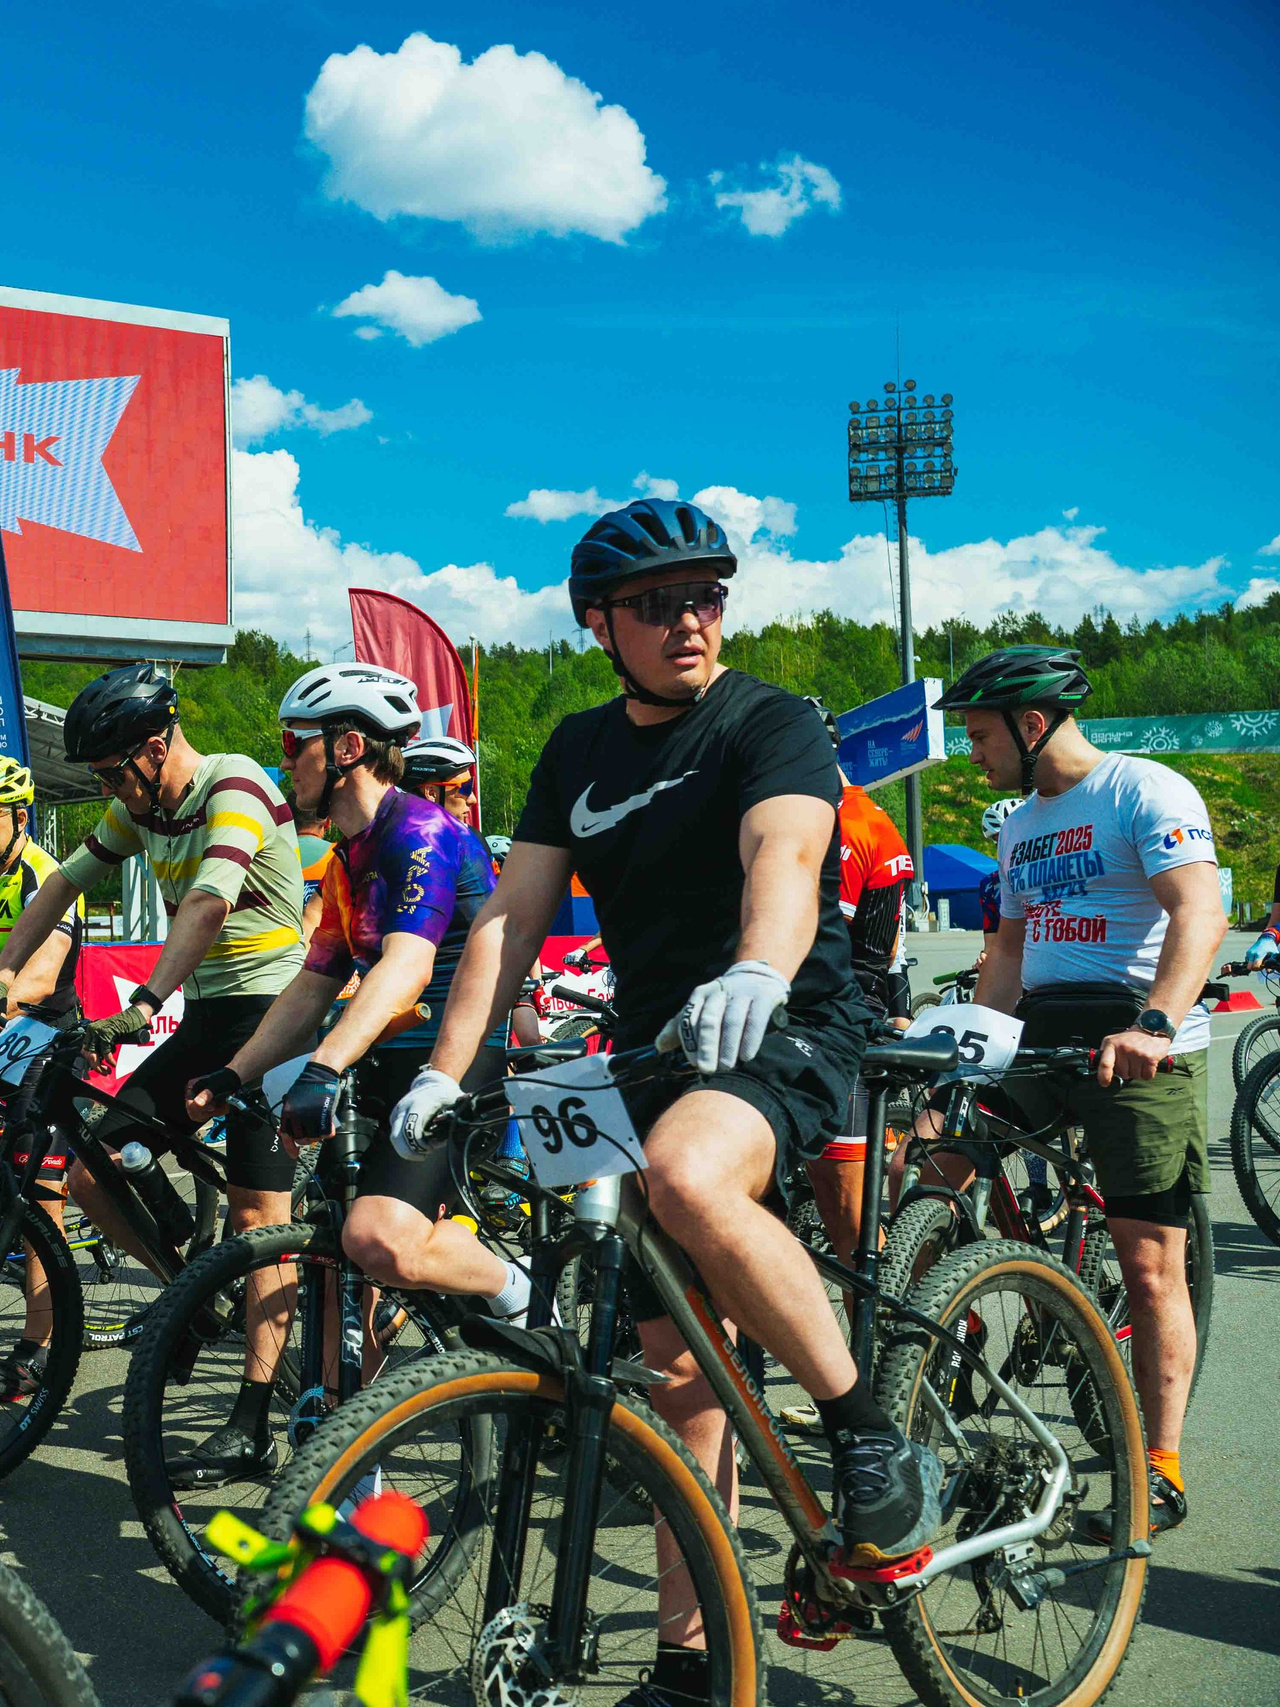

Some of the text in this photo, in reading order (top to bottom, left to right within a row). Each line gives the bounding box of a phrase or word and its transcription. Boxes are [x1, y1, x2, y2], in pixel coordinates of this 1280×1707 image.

[1009, 824, 1093, 868] #ЗАБЕГ2025
[1187, 829, 1213, 841] ПС
[1028, 850, 1105, 889] ПЛАНЕТЫ
[1032, 914, 1107, 943] С ТОБОЙ
[930, 1024, 989, 1065] 5
[531, 1096, 598, 1154] 96
[41, 1156, 63, 1166] Fondo
[89, 1331, 125, 1342] PATROL
[341, 1291, 364, 1370] FOX
[951, 1319, 968, 1368] ROSHOX
[19, 1387, 50, 1432] DT SWISS
[721, 1337, 799, 1470] ВЕЛОПРОКАТ
